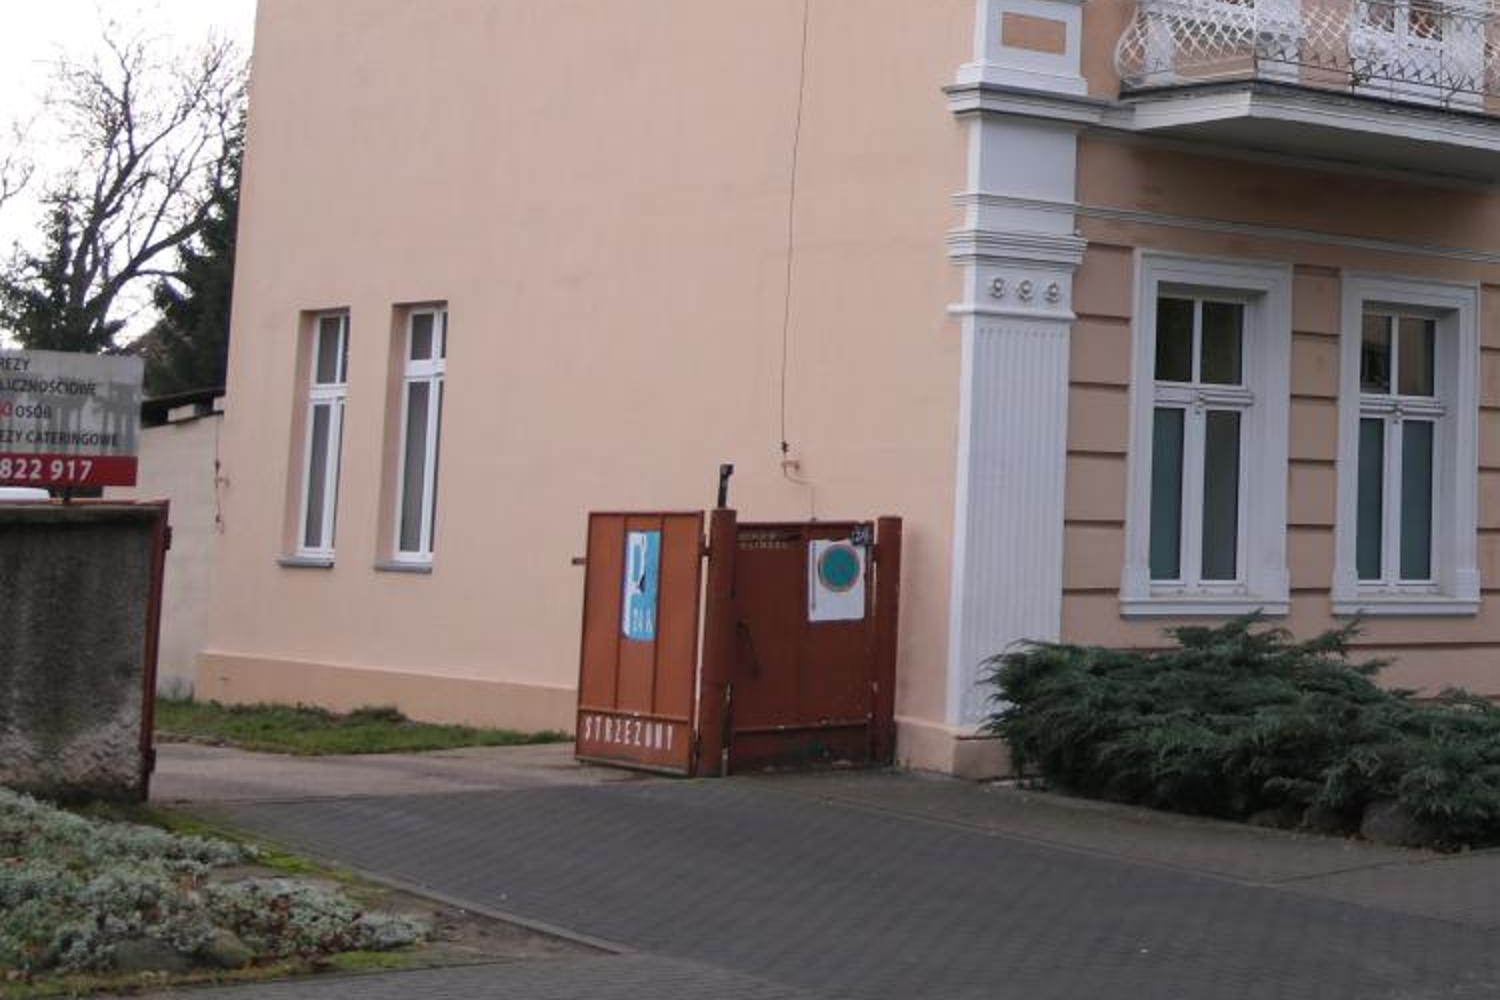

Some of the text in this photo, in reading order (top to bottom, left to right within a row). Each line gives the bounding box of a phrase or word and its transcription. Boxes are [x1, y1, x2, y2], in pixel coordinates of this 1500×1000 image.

[26, 430, 118, 447] CATERINGOWE
[0, 457, 93, 481] 822 917
